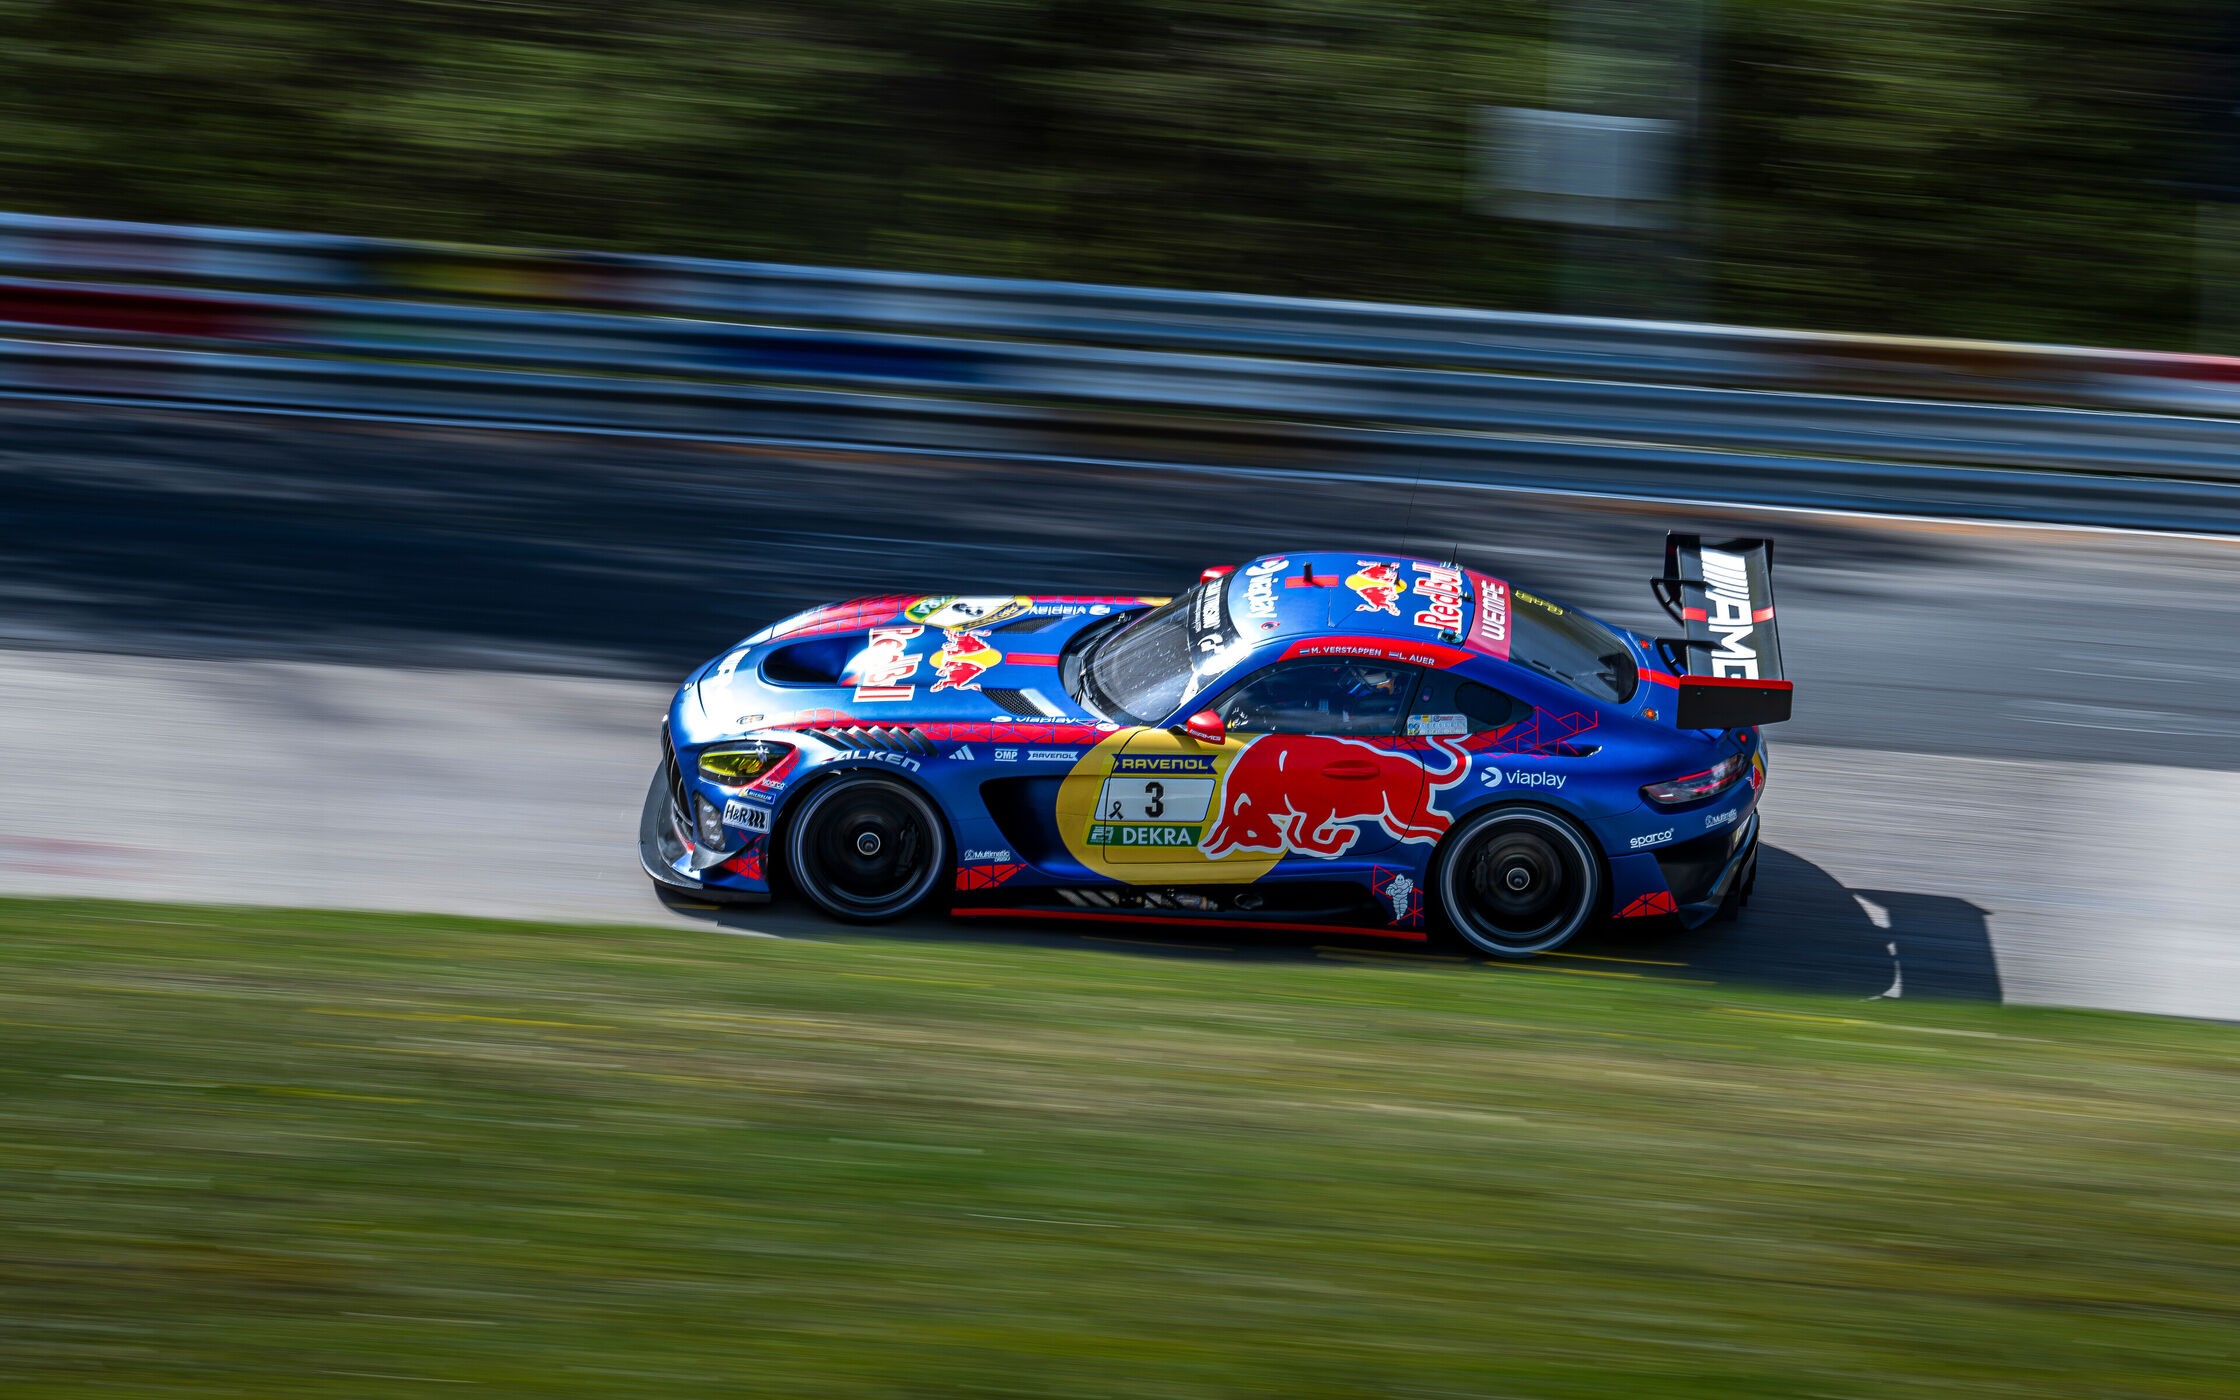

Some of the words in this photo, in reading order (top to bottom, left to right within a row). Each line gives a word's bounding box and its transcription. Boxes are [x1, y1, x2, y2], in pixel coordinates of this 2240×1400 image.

[1481, 579, 1506, 641] WEMPE
[1311, 646, 1321, 654] M.
[1323, 646, 1382, 657] VERSTAPPEN
[1398, 652, 1407, 660] L.
[1409, 654, 1435, 666] AUER
[994, 750, 1019, 760] OMP
[1032, 751, 1074, 760] RAVENOL
[1121, 758, 1209, 770] RAVENOL
[1506, 769, 1567, 790] viaplay
[1144, 782, 1165, 818] 3
[725, 804, 748, 825] H&R
[1122, 827, 1193, 845] DEKRA
[1629, 829, 1674, 848] sparco
